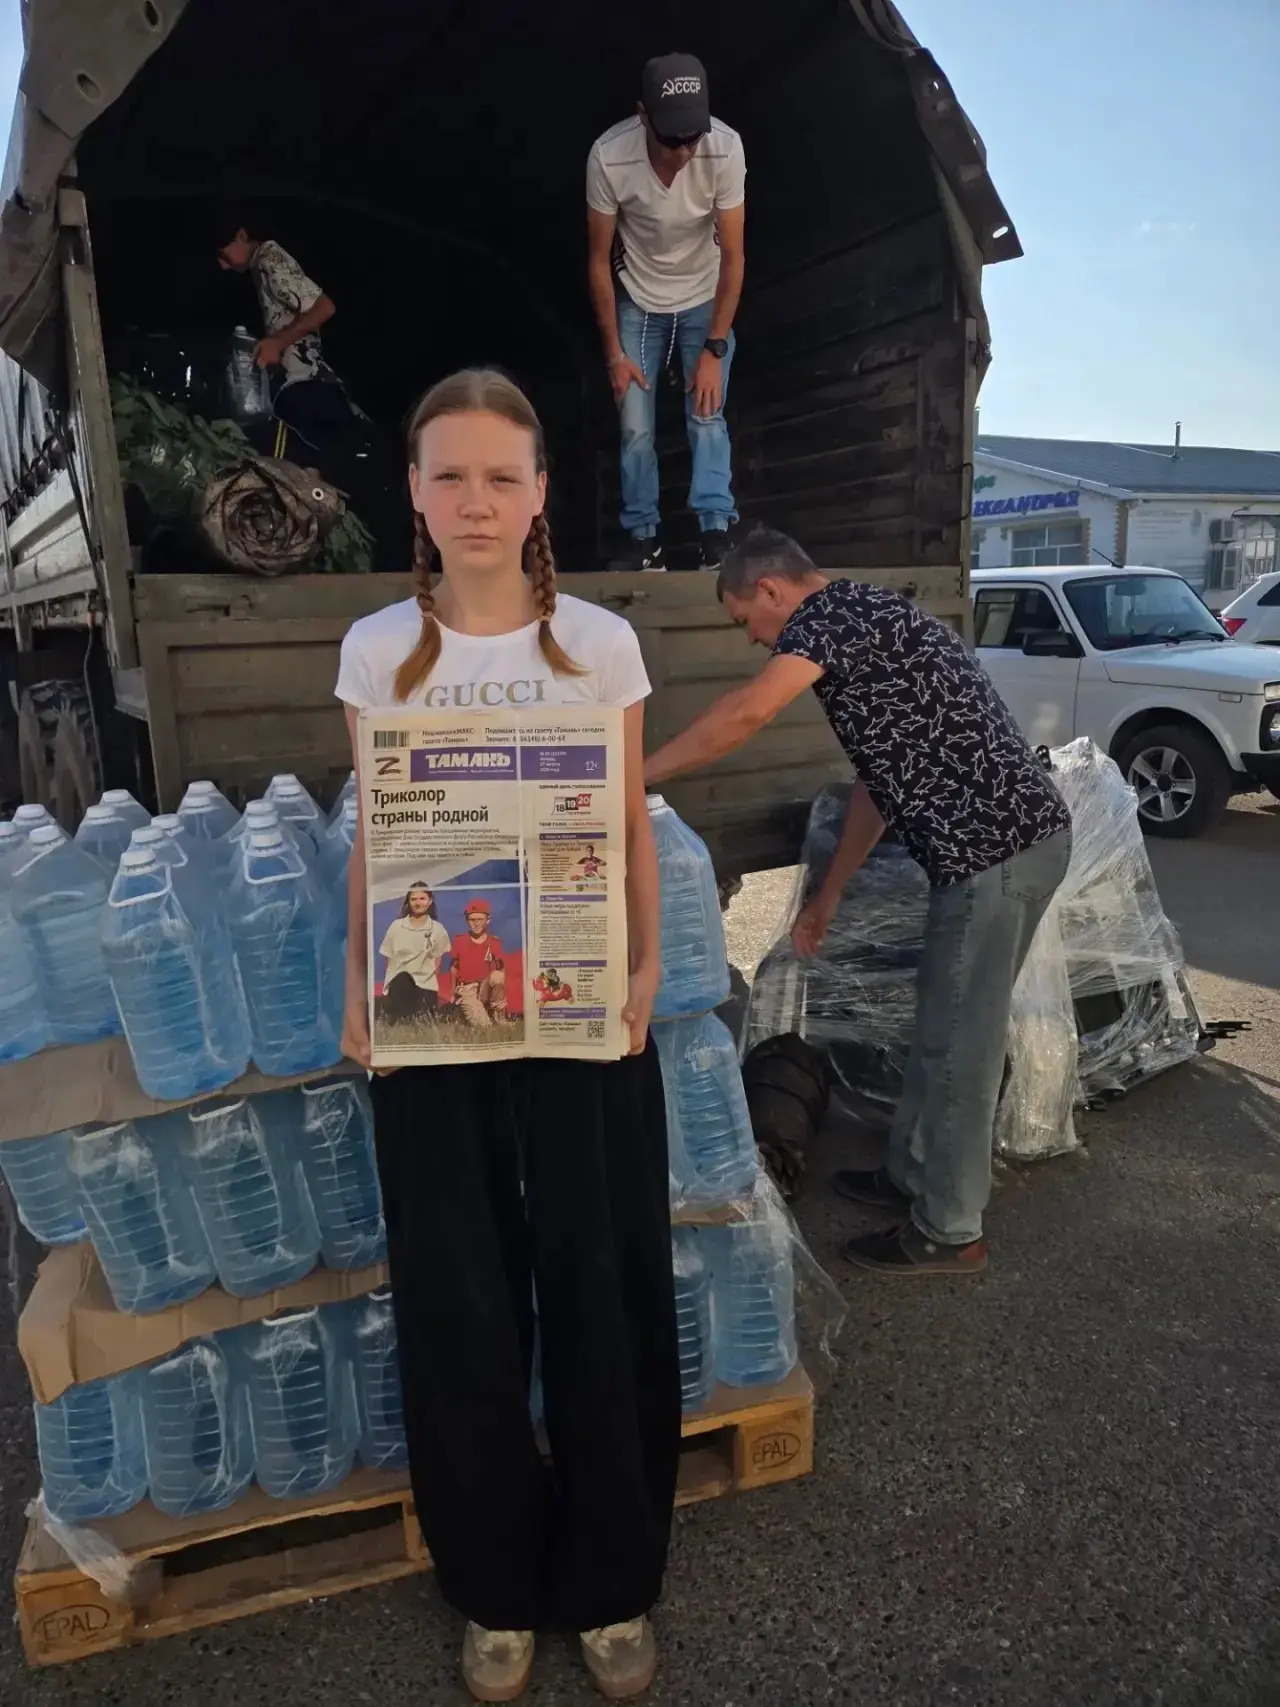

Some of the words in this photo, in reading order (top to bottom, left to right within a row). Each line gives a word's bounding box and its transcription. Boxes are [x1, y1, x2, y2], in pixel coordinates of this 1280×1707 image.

[675, 81, 701, 95] СССР
[424, 679, 546, 708] GUCCI
[485, 727, 525, 735] Подпишитсь
[425, 752, 511, 769] ТАМАНЬ
[370, 788, 446, 809] Триколор
[555, 804, 565, 812] 18
[567, 800, 576, 808] 19
[578, 796, 590, 805] 20
[371, 809, 427, 828] страны
[432, 805, 489, 826] родной
[42, 1611, 100, 1642] EPAL
